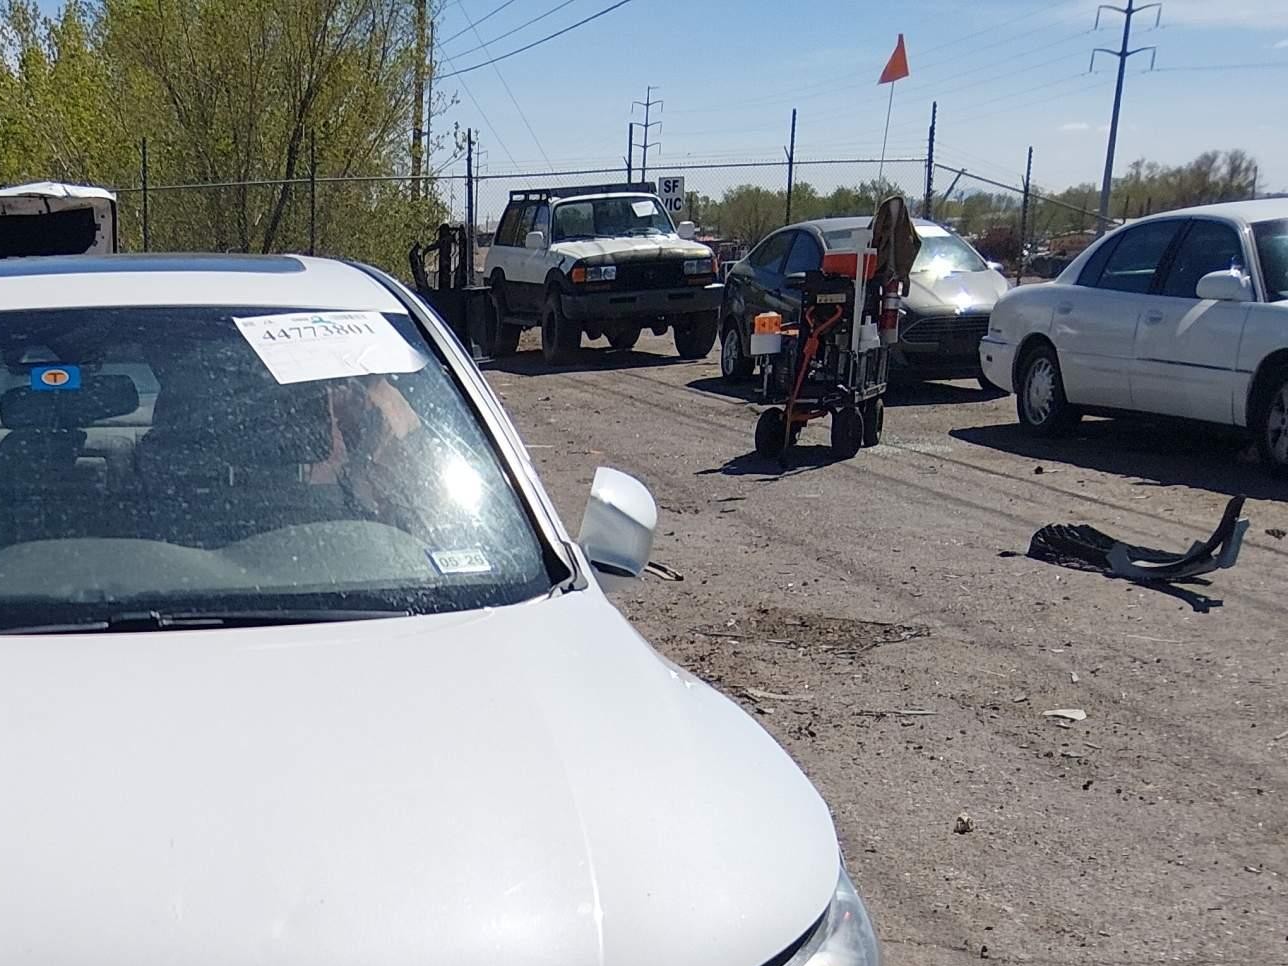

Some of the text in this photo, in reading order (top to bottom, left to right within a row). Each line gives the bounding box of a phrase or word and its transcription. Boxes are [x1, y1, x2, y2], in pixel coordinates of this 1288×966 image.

[663, 180, 679, 193] SF
[263, 324, 375, 341] 44773801
[47, 372, 65, 383] T
